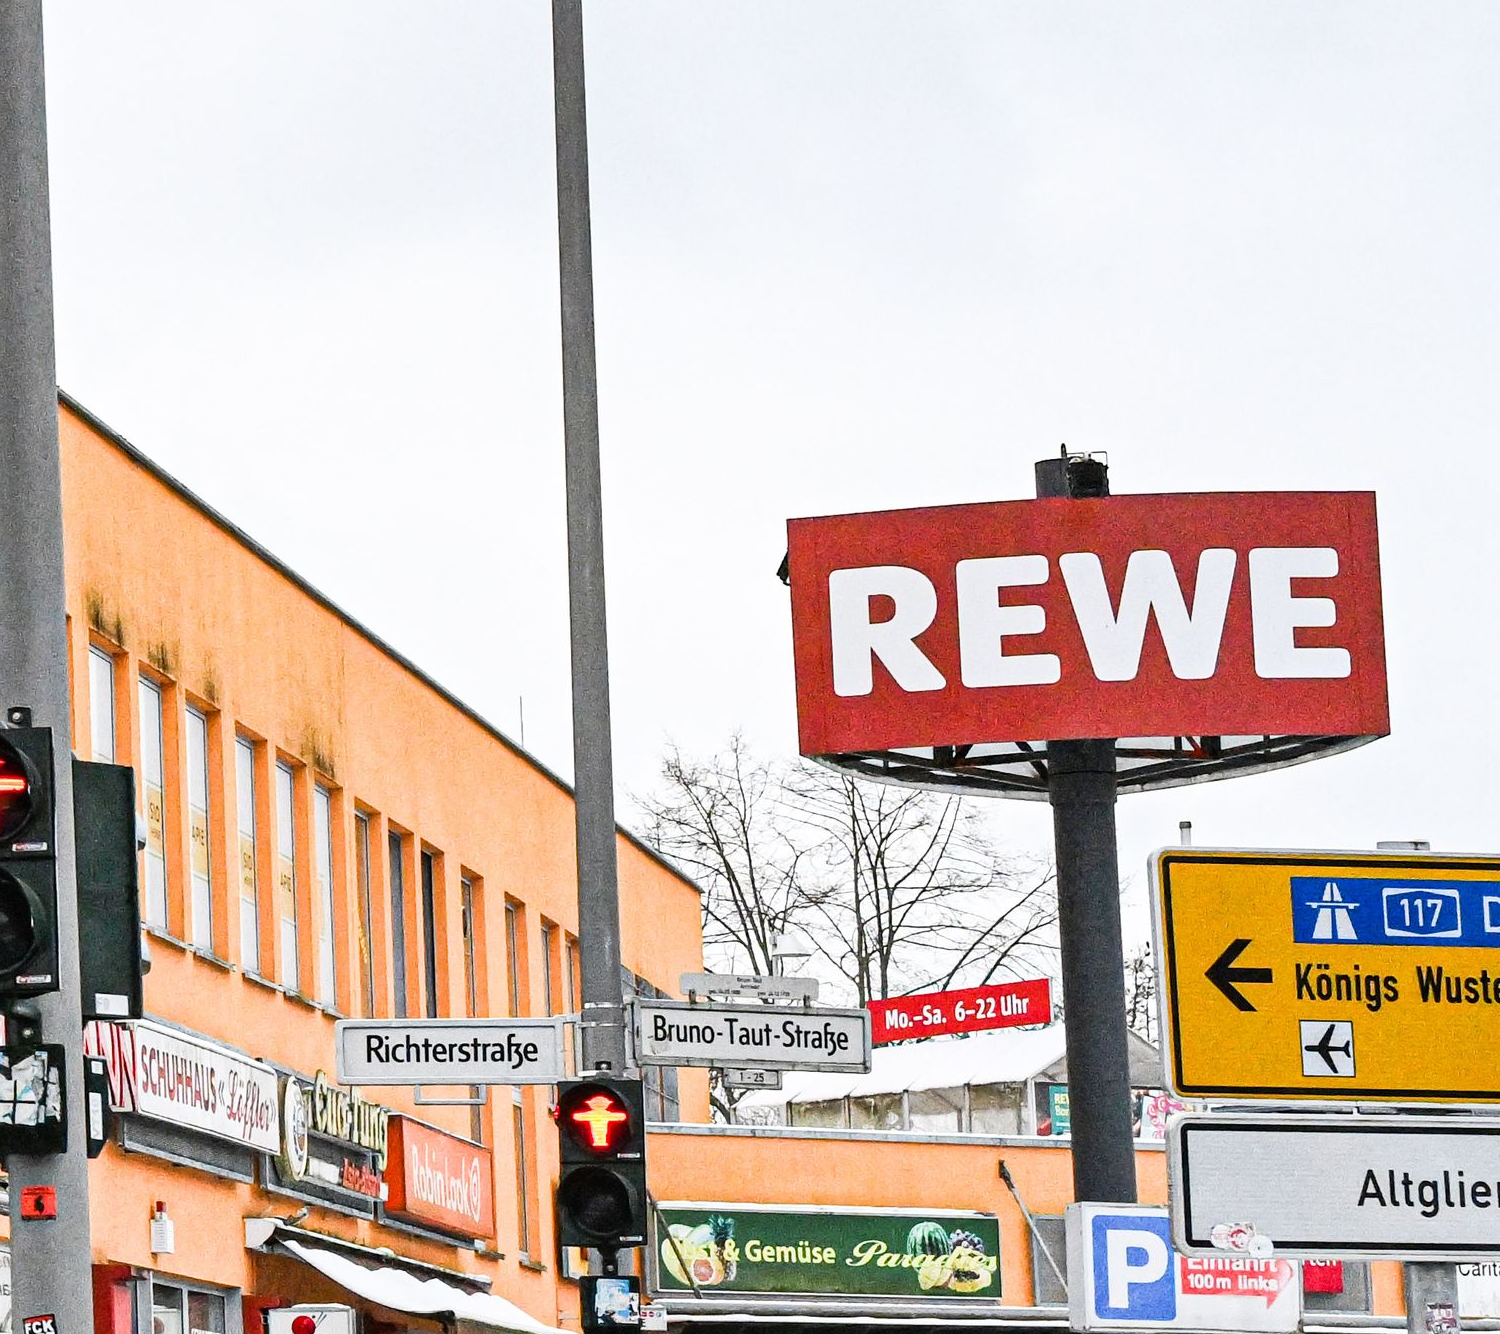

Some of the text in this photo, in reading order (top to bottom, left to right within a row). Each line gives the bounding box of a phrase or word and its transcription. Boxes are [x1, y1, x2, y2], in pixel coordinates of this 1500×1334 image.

[828, 546, 1353, 698] REWE
[1399, 899, 1443, 928] 117
[1000, 994, 1029, 1017] Uhr
[1296, 962, 1399, 1012] Königs
[365, 1034, 539, 1070] Richterstraße
[653, 1014, 849, 1056] Bruno-Taut-Straße
[140, 1044, 218, 1114] SCHUHHAUS
[754, 1072, 765, 1083] 25
[1357, 1168, 1500, 1218] Altglie
[722, 1239, 740, 1262] &
[745, 1239, 836, 1265] Gemüse
[846, 1239, 997, 1271] Paradies
[1105, 1227, 1169, 1312] P
[1238, 1274, 1279, 1292] links
